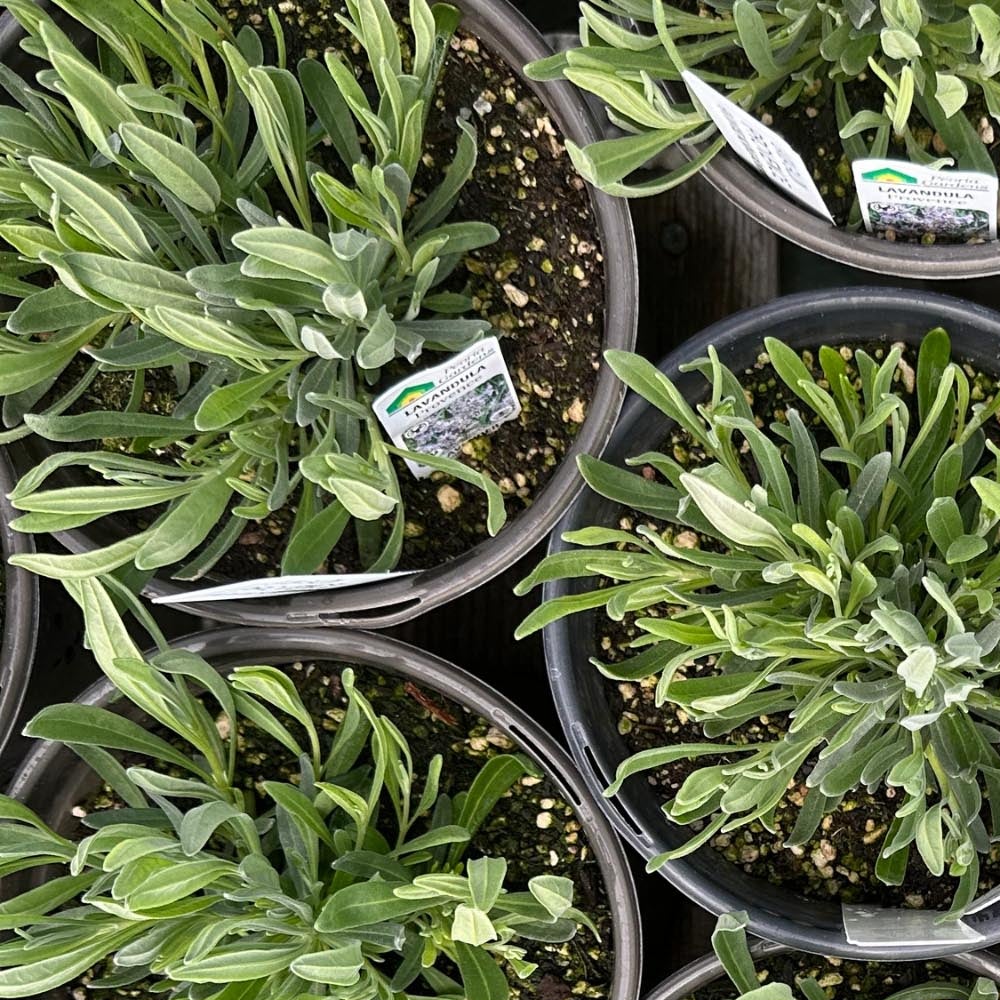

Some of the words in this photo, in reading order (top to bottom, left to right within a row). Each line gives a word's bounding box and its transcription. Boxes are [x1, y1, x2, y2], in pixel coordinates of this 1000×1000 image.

[878, 186, 974, 199] LAVANDULA
[888, 194, 968, 205] Provence
[404, 364, 486, 417] LAVANDULA
[415, 375, 484, 419] Provence
